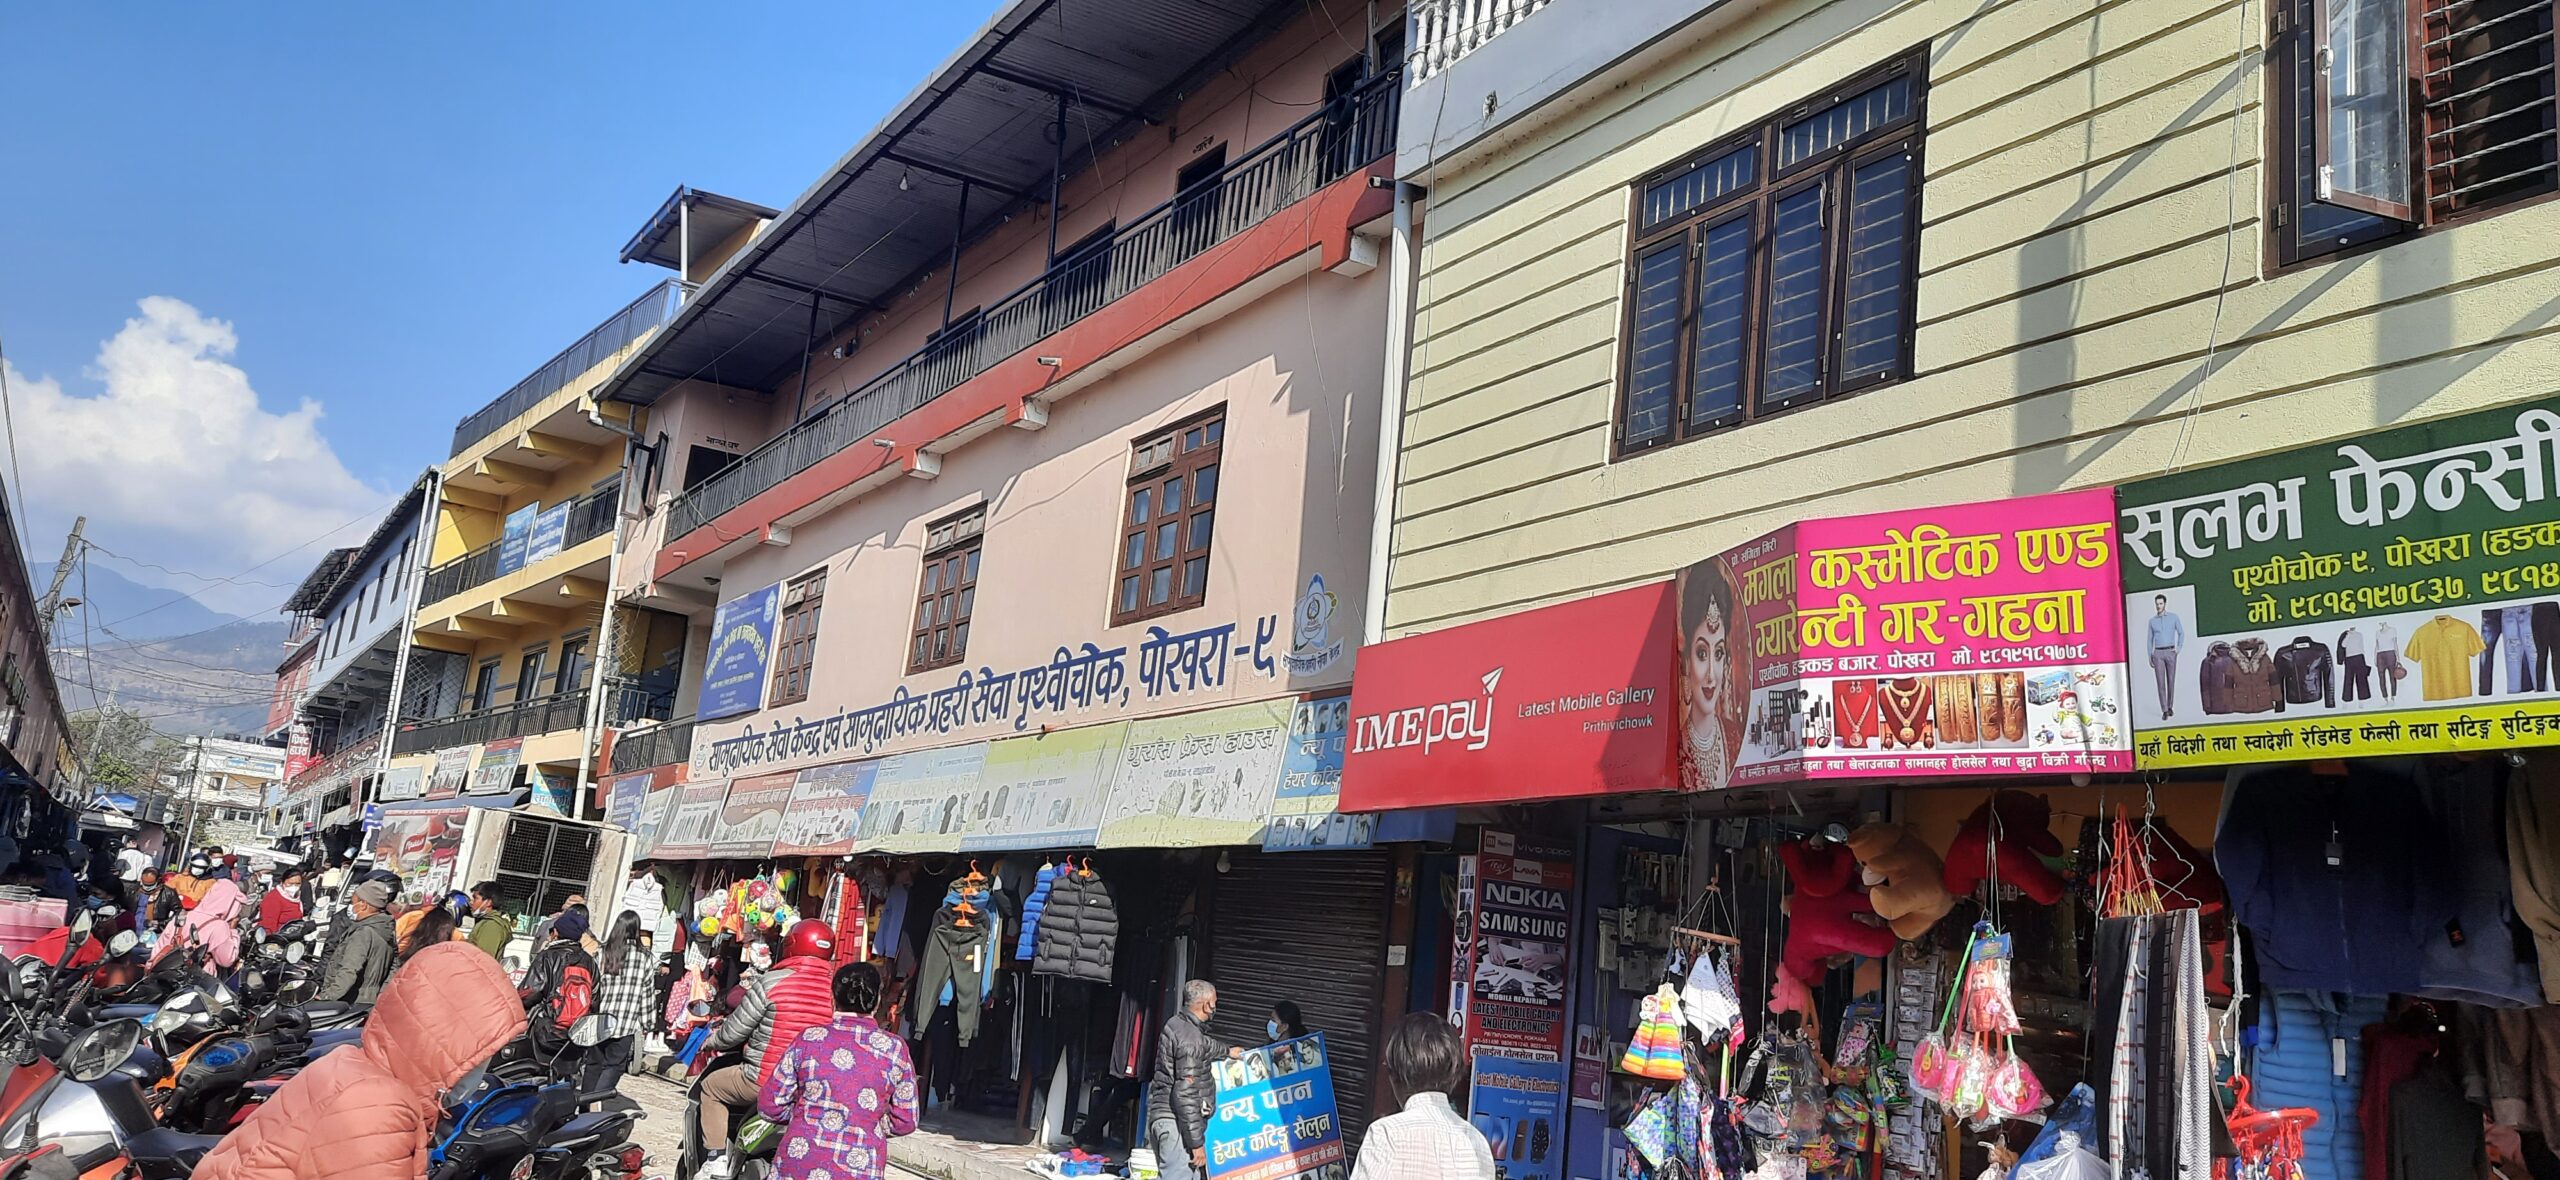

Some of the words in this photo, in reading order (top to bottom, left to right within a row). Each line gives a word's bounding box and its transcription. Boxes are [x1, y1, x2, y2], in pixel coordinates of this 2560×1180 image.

[2121, 476, 2306, 579] सुलभ
[2330, 408, 2560, 527] फेन्सी
[1743, 553, 1799, 606] मंगला
[1810, 524, 2001, 591] कस्मेटिक
[2014, 521, 2113, 572] एण्ड
[2384, 534, 2472, 568] पोखरा
[2247, 593, 2282, 624] मो.
[1887, 649, 1936, 669] पोखरा
[1952, 645, 1975, 666] मो.
[1518, 697, 1556, 719] Latest
[1559, 693, 1603, 713] Mobile
[1606, 687, 1656, 708] Gallery
[708, 723, 767, 778] सामुदायिक
[766, 719, 792, 764] सेवा
[791, 716, 825, 758] केन्द्र
[823, 705, 845, 754] एवं
[844, 686, 929, 754] सामुदायिक
[925, 670, 974, 733] प्रहरी
[972, 666, 1017, 724] सेवा
[1583, 718, 1654, 734] Prithivichowk
[1301, 738, 1328, 760] न्यू
[2139, 735, 2161, 759] यहाँ
[2168, 733, 2206, 756] विदेशी
[2212, 736, 2237, 752] तथा
[2243, 730, 2294, 751] स्वादेशी
[2300, 725, 2353, 749] रेडिमेड
[2359, 719, 2402, 743] फेन्सी
[2408, 723, 2439, 741] तथा
[1827, 759, 1845, 772] तथा
[1952, 754, 1988, 769] होलसेल
[1992, 756, 2012, 768] तथा
[1283, 768, 1310, 790] हेयर
[1517, 843, 1543, 854] vivo
[1485, 882, 1567, 912] NOKIA
[1479, 910, 1567, 939] SAMSUNG
[1472, 1002, 1499, 1016] LATEST
[1501, 1005, 1530, 1019] MOBILE
[1487, 993, 1512, 1002] MOBILE
[1513, 996, 1548, 1006] REPAIRING
[1481, 1017, 1498, 1029] AND
[1218, 1095, 1260, 1122] न्यू
[1261, 1080, 1312, 1109] पवन
[1212, 1137, 1247, 1165] हेयर
